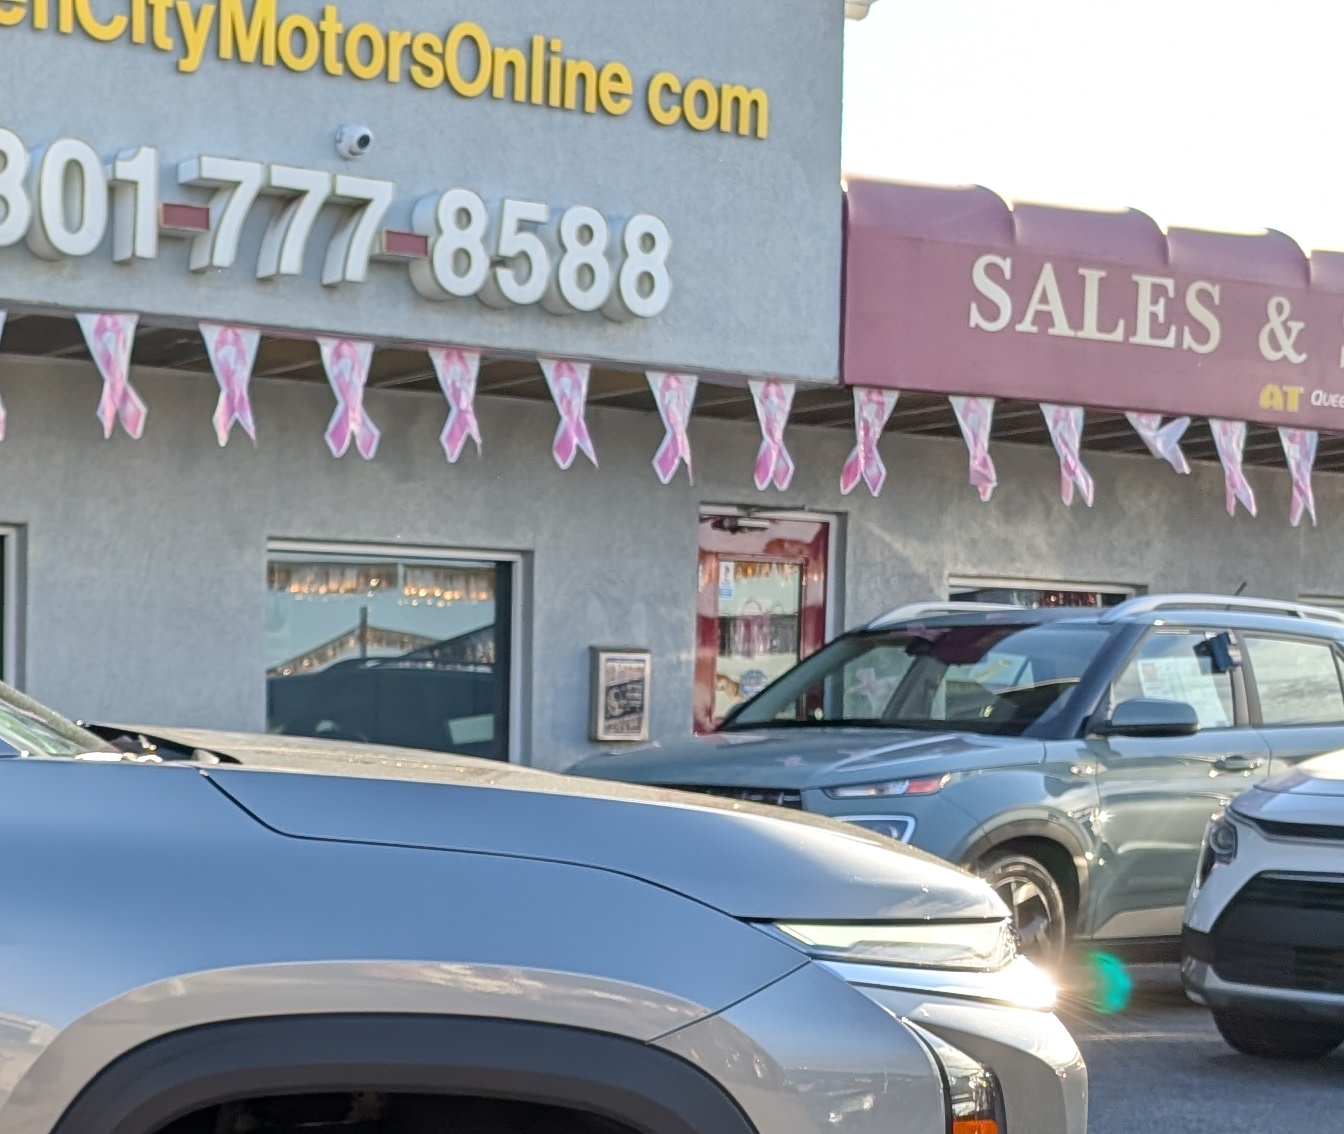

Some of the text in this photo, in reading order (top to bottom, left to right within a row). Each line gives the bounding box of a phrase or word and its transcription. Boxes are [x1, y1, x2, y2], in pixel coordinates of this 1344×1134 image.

[969, 254, 1222, 355] SALES
[1258, 296, 1308, 364] &
[1258, 383, 1305, 413] AT
